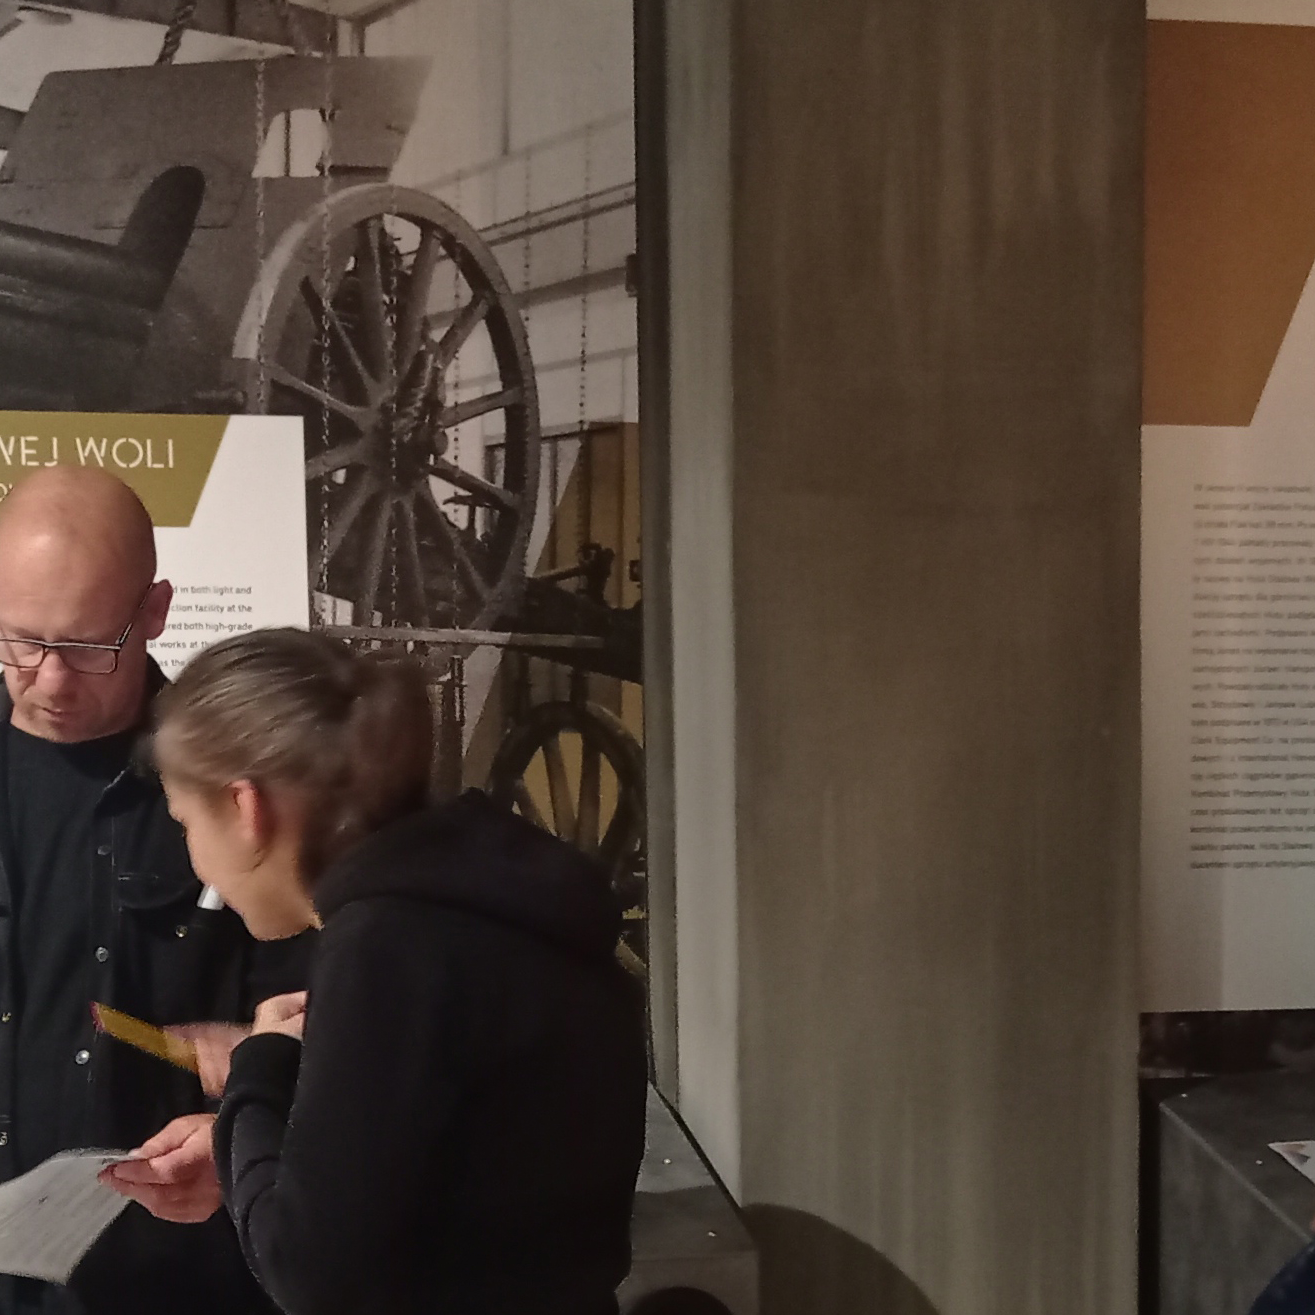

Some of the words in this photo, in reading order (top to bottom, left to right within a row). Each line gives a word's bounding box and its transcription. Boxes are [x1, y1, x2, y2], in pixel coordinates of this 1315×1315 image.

[74, 437, 175, 469] WOLI
[235, 586, 252, 594] and
[238, 604, 253, 612] the
[184, 622, 203, 630] both
